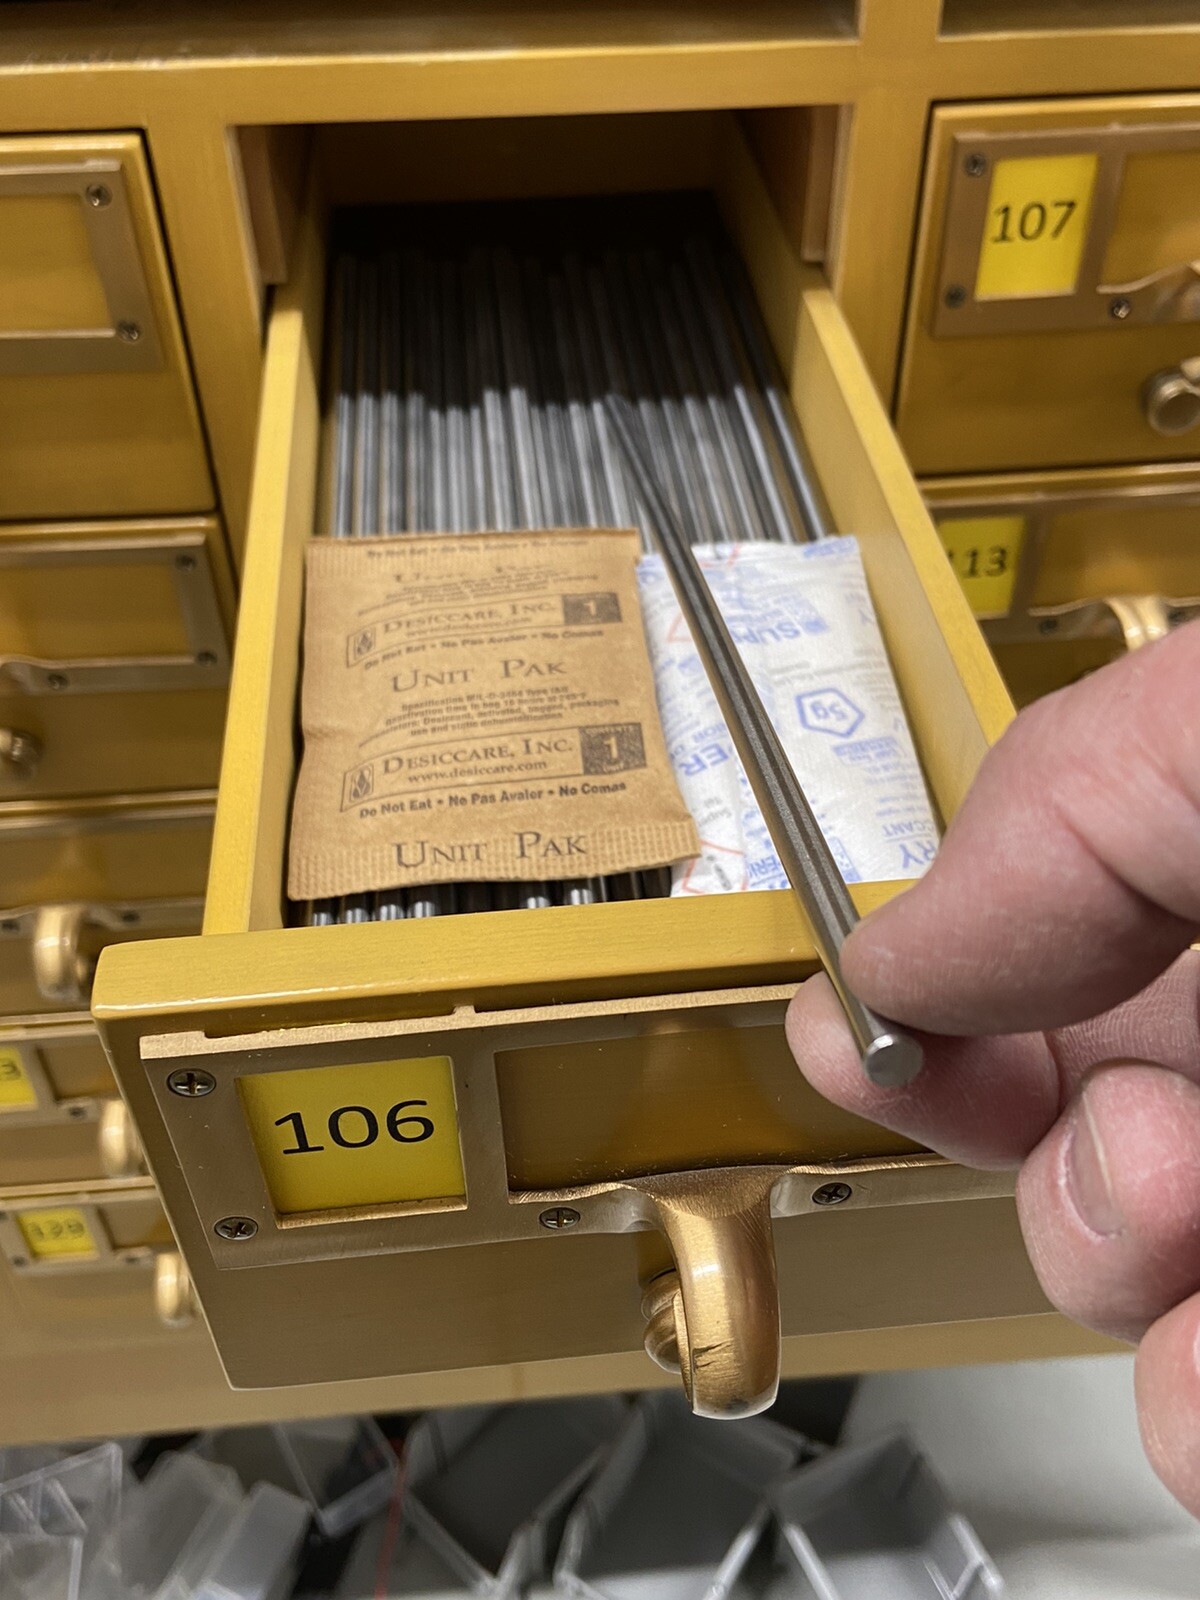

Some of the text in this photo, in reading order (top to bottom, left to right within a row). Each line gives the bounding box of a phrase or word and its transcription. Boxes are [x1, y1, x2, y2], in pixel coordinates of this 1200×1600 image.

[991, 200, 1077, 244] 107
[603, 736, 619, 761] 1
[407, 760, 548, 784] www.desiccare.com
[359, 781, 628, 819] Do Not Eat No Pas Avaler No Comas
[391, 830, 588, 869] UNIT PAK
[274, 1099, 435, 1156] 106
